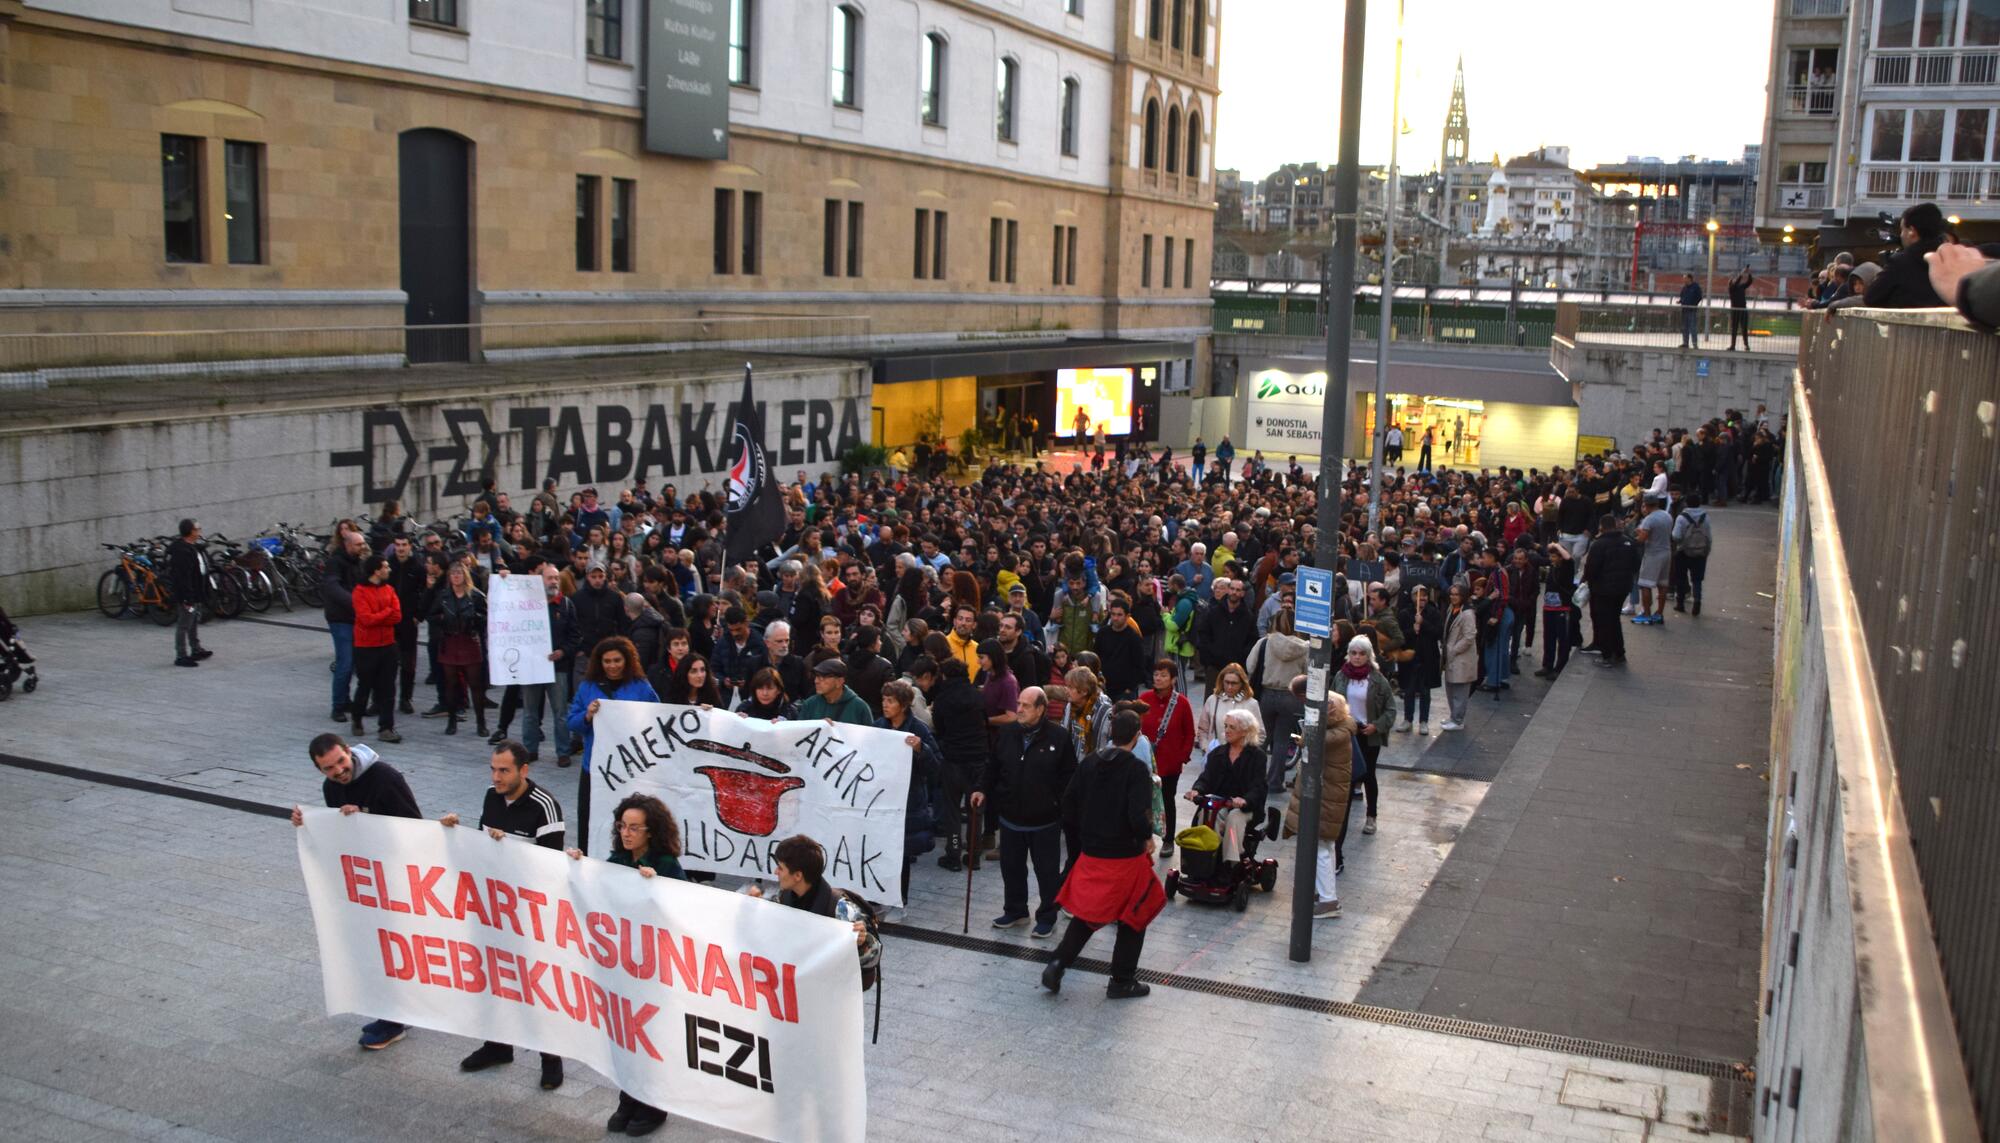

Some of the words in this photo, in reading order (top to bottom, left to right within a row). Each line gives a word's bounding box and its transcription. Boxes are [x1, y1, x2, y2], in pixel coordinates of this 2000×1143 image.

[1266, 418, 1308, 429] DONOSTIA
[1285, 383, 1323, 396] adi
[509, 398, 862, 490] TABAKALERA
[1266, 428, 1283, 437] SAN
[1287, 429, 1323, 440] SEBASTI
[598, 709, 701, 791] KALEKO
[340, 854, 799, 1024] ELKARTASUNARI
[377, 928, 664, 1063] DEBEKURIK
[684, 1012, 775, 1094] EZ!
